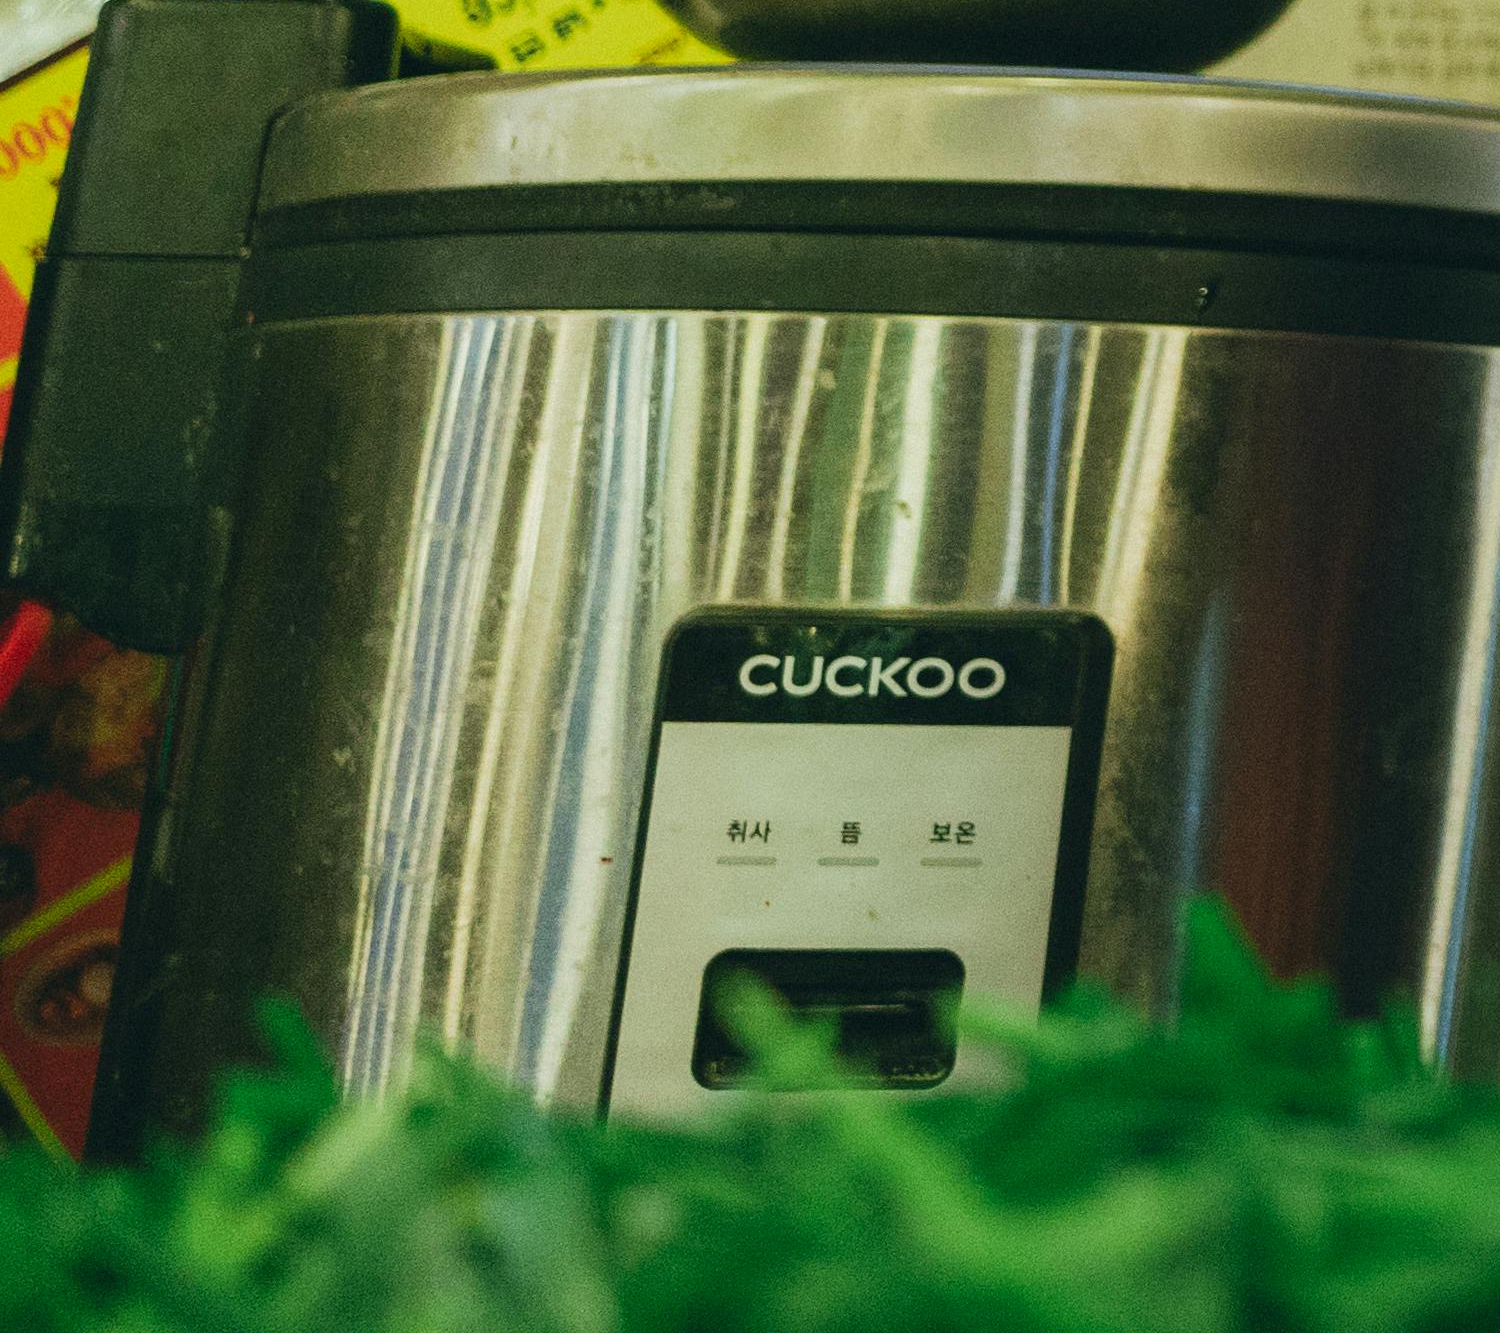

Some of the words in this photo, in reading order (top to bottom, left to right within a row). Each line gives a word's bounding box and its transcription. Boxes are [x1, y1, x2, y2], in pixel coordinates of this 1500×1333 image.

[739, 653, 1006, 699] CUCKOO
[726, 819, 772, 845] 취사
[840, 820, 863, 845] 뜸
[929, 820, 978, 846] 보온
